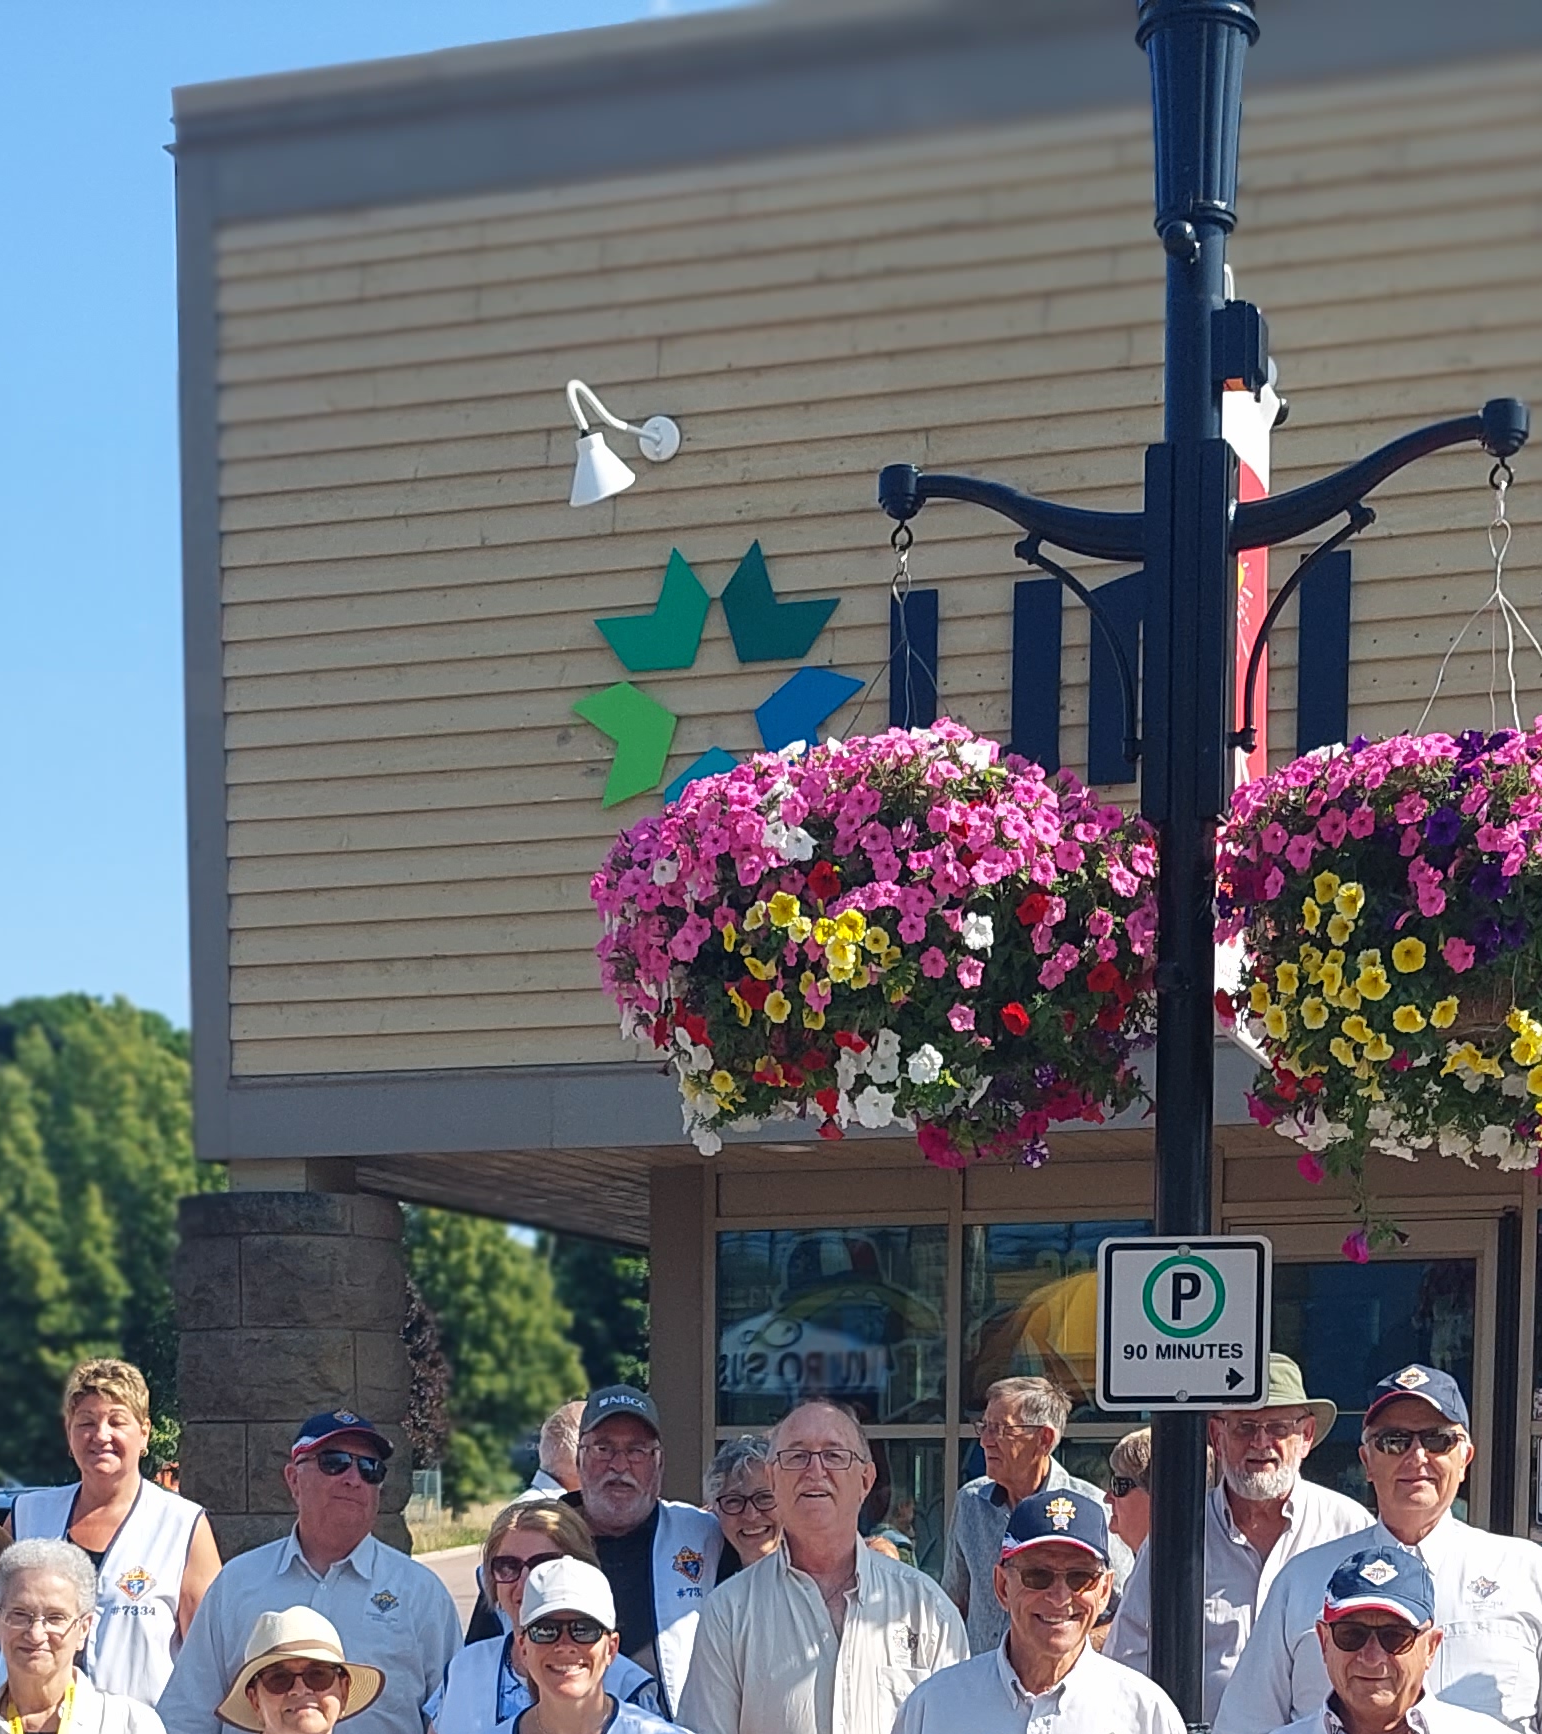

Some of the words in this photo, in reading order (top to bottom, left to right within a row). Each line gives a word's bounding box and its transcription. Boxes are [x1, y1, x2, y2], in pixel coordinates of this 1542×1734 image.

[1171, 1272, 1202, 1321] P
[1123, 1343, 1148, 1361] 90
[1155, 1342, 1244, 1361] MINUTES
[609, 1395, 648, 1412] NBCC
[110, 1604, 157, 1617] #7334
